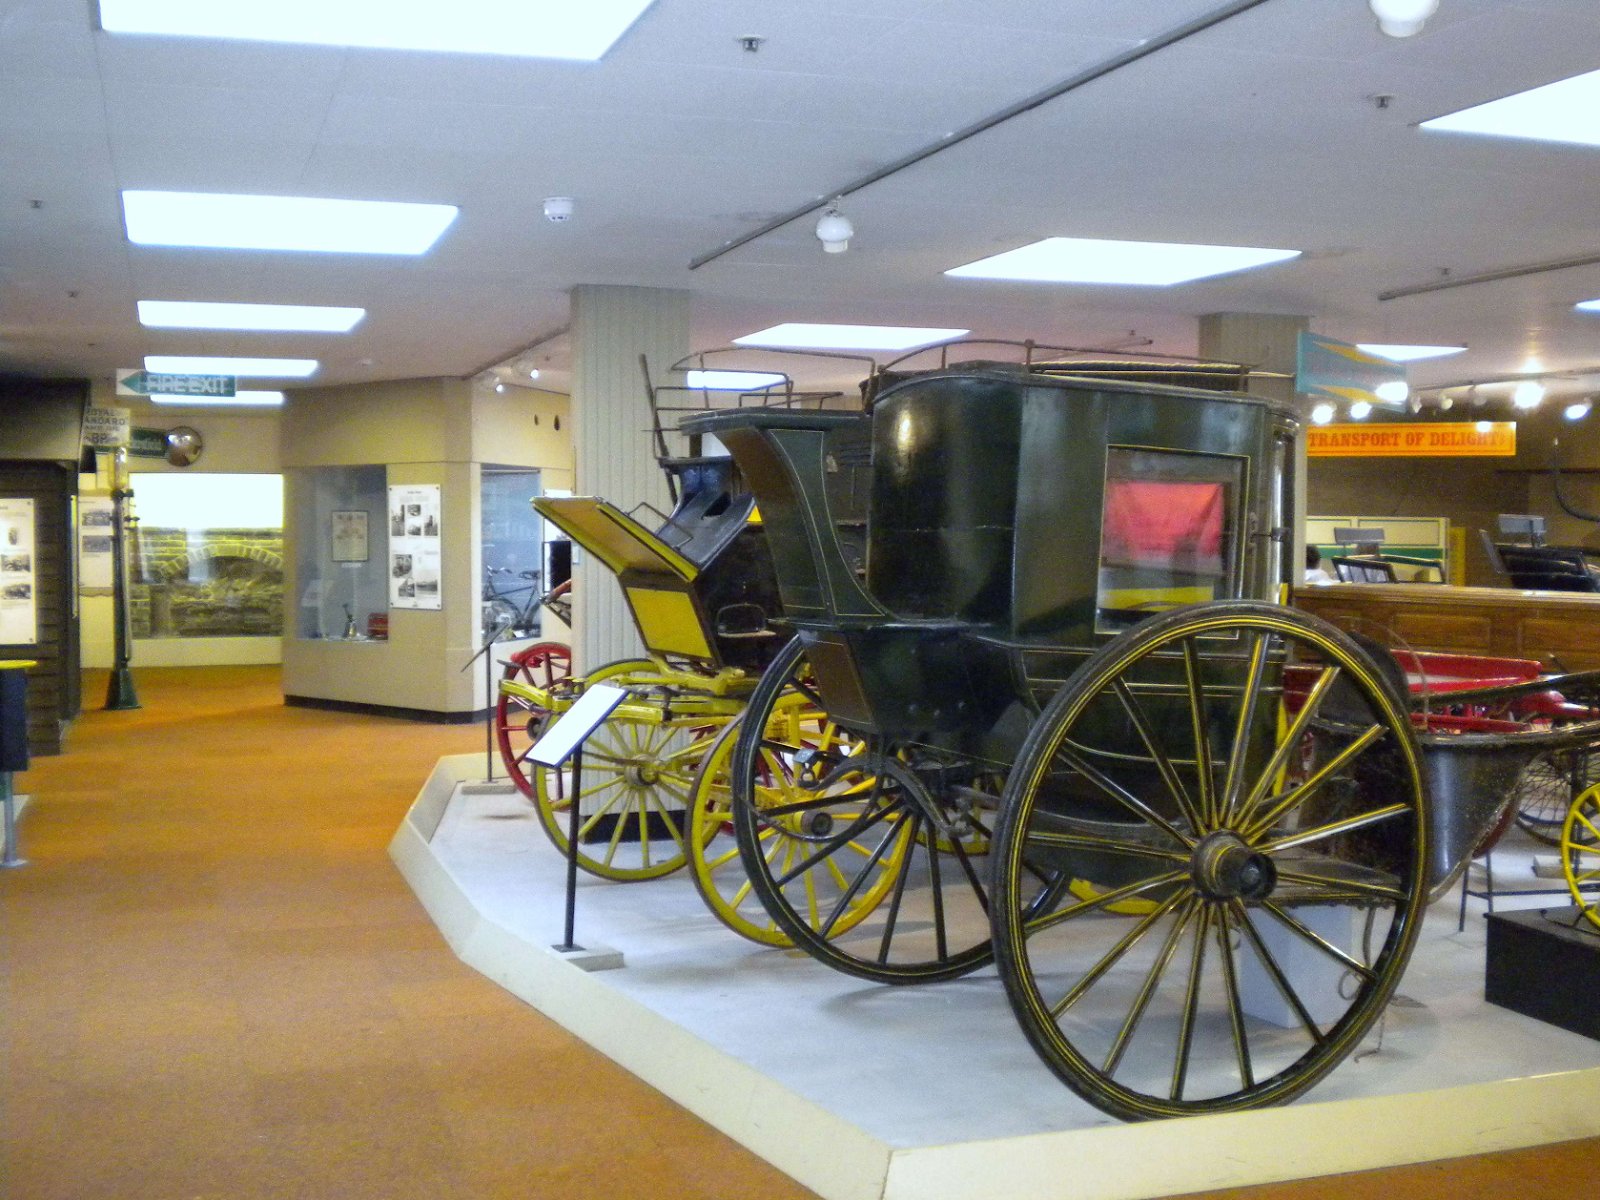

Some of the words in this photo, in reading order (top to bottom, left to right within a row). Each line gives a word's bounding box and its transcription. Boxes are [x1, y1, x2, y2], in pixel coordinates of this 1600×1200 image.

[147, 375, 186, 392] FIRE
[188, 376, 228, 393] EXIT
[1308, 432, 1400, 447] TRANSPORT
[1406, 432, 1425, 446] OF
